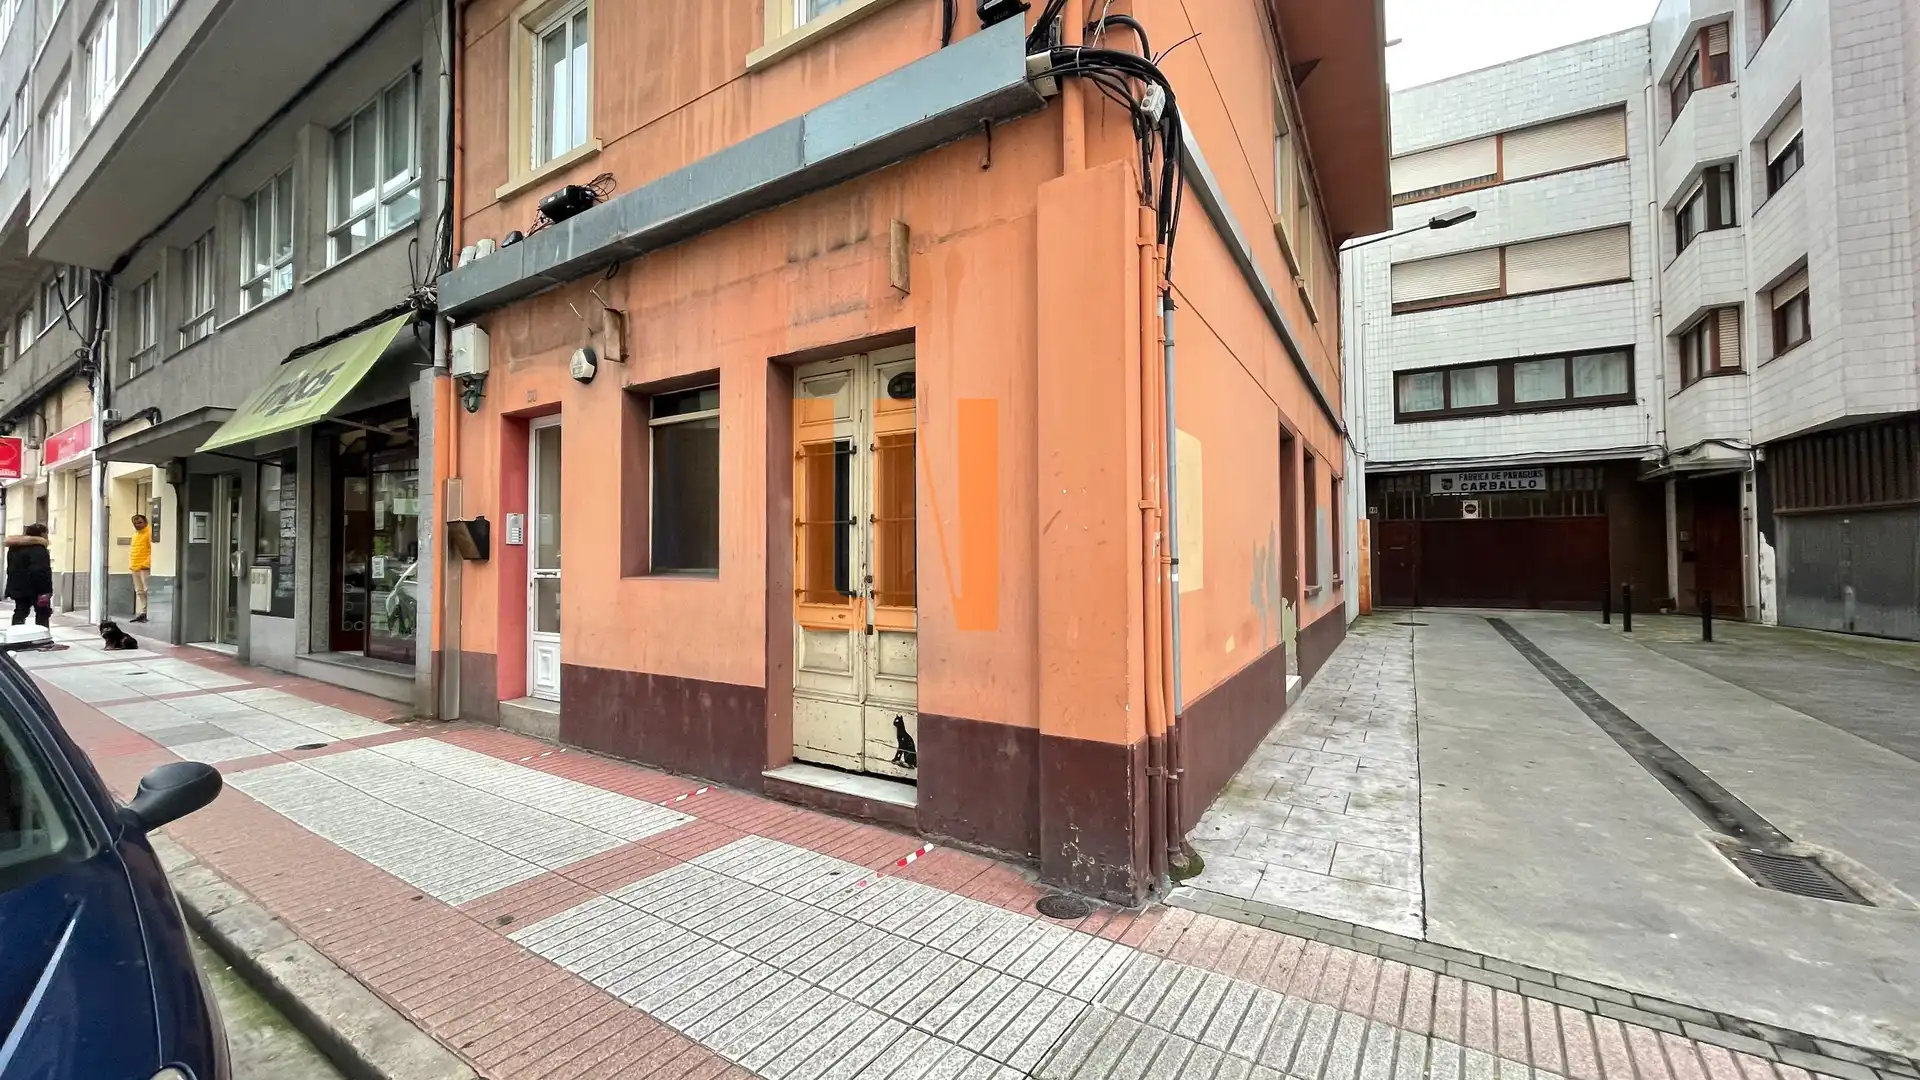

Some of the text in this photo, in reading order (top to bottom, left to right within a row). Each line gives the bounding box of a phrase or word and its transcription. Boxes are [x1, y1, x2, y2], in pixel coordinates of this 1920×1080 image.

[1459, 470, 1543, 481] FABRICA DE PARAGUAS
[1461, 480, 1537, 491] CARBALLO
